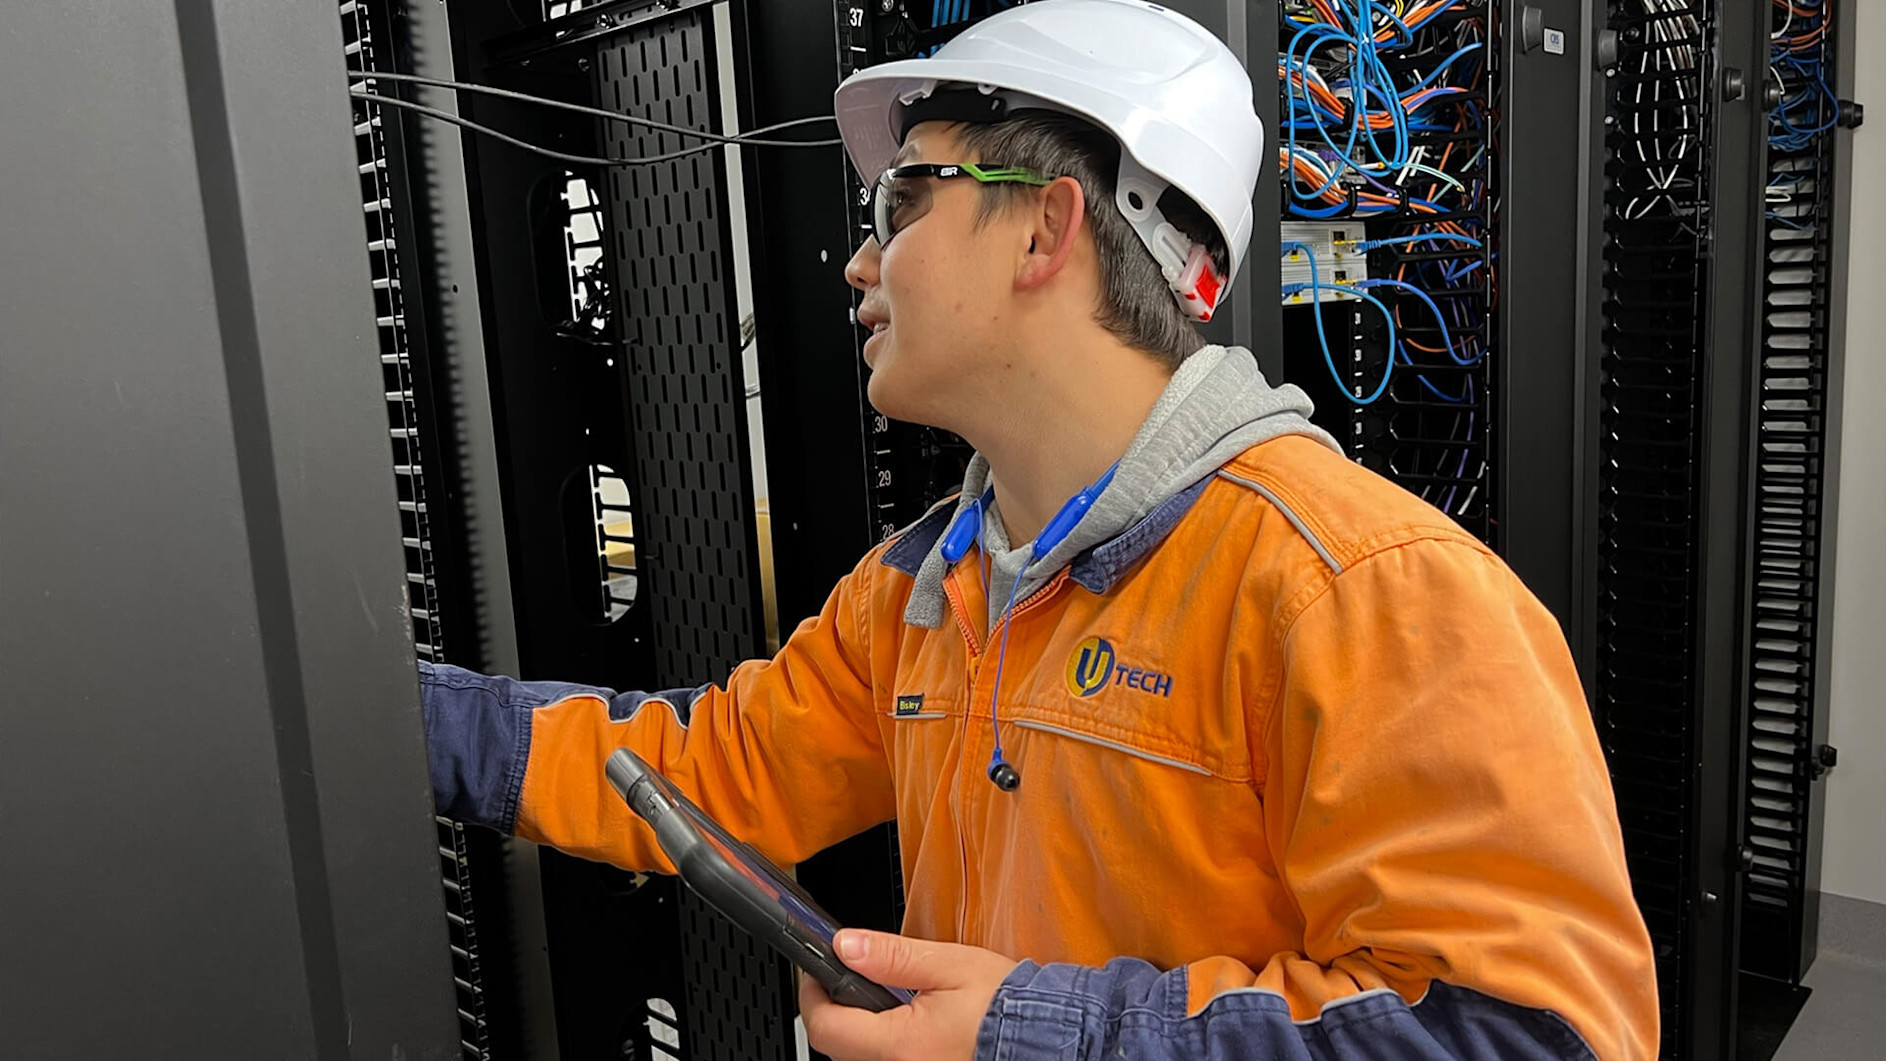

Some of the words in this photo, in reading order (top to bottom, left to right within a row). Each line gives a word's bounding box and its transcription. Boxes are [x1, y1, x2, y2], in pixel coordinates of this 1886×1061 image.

[850, 8, 863, 27] 37
[875, 416, 888, 432] 30
[879, 470, 891, 487] 29
[1115, 664, 1173, 698] TECH
